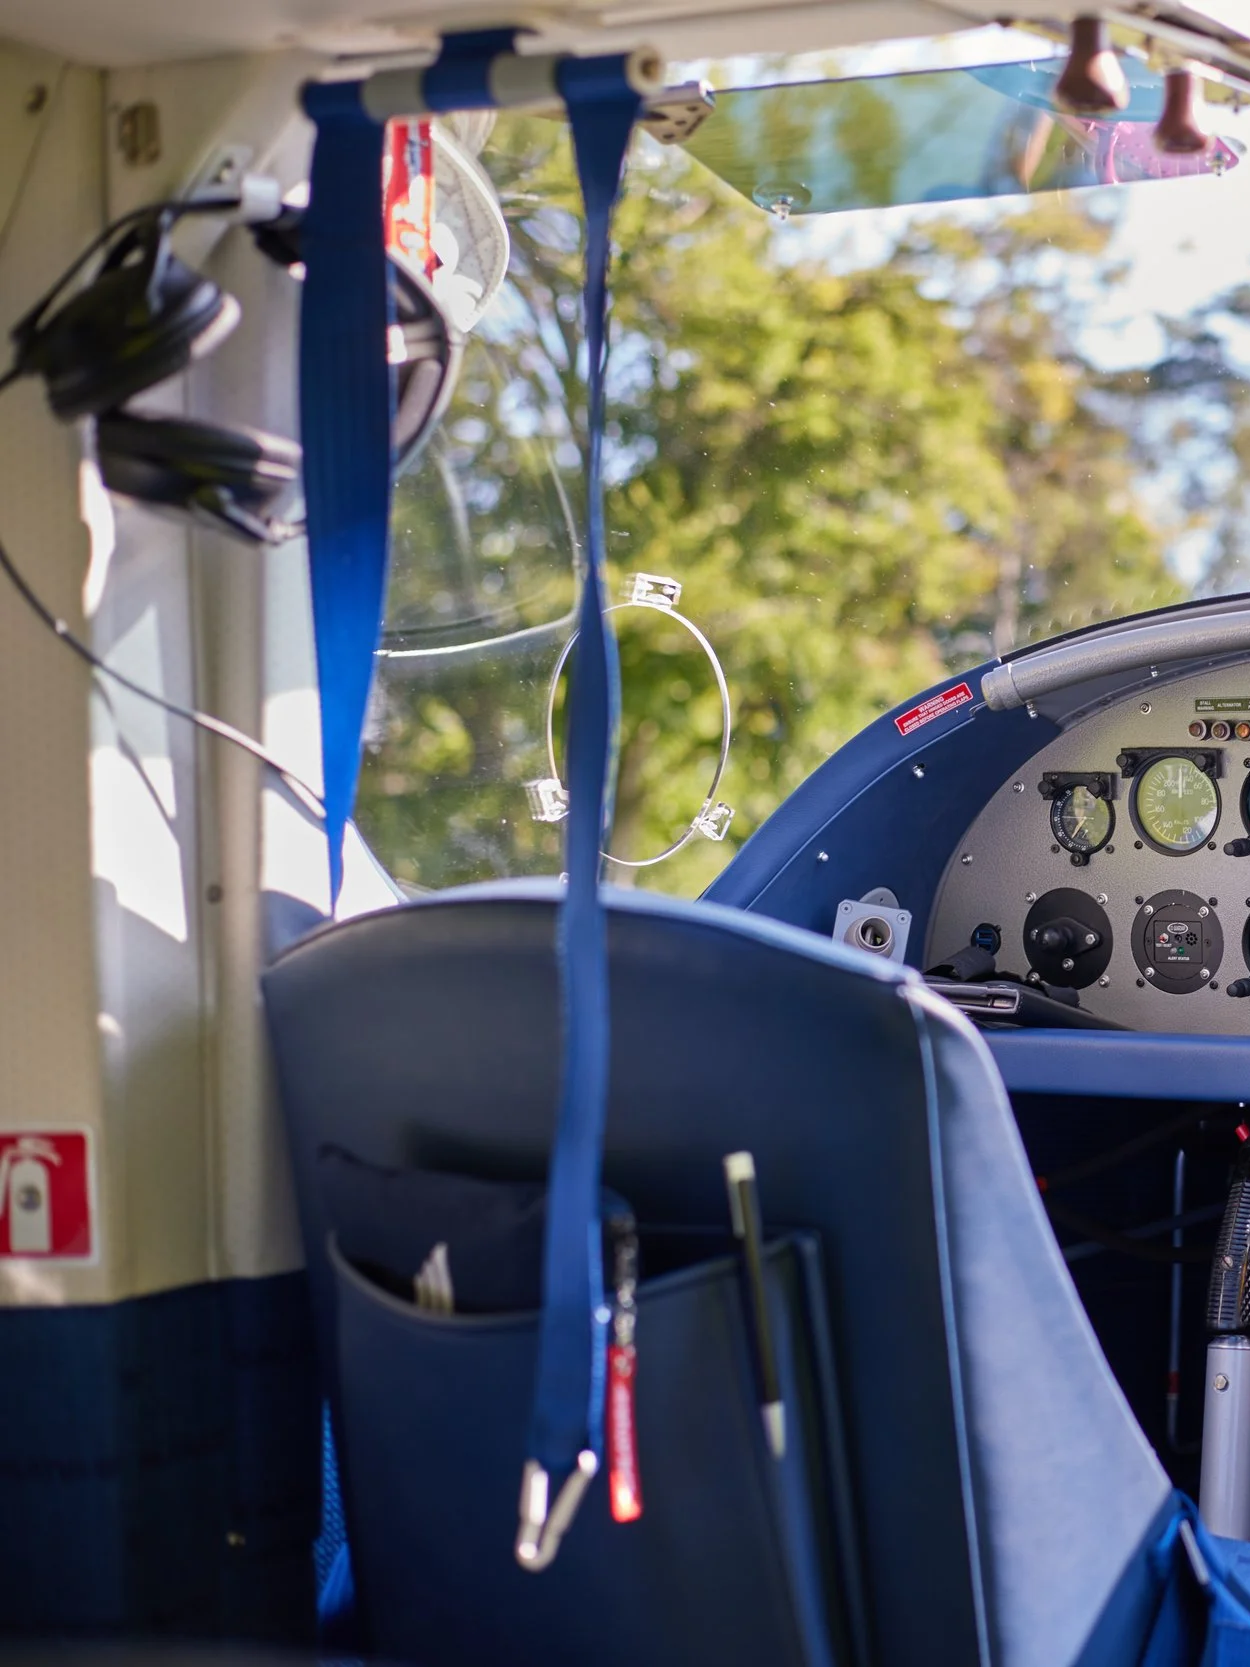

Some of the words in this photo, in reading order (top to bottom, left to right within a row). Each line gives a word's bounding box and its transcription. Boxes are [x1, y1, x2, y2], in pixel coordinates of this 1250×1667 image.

[918, 696, 944, 712] WARNING
[942, 696, 957, 705] DOORS
[904, 721, 920, 732] CLOSED
[919, 713, 935, 723] BEFORE
[934, 701, 957, 715] OPERATING
[956, 695, 969, 704] FLAPS
